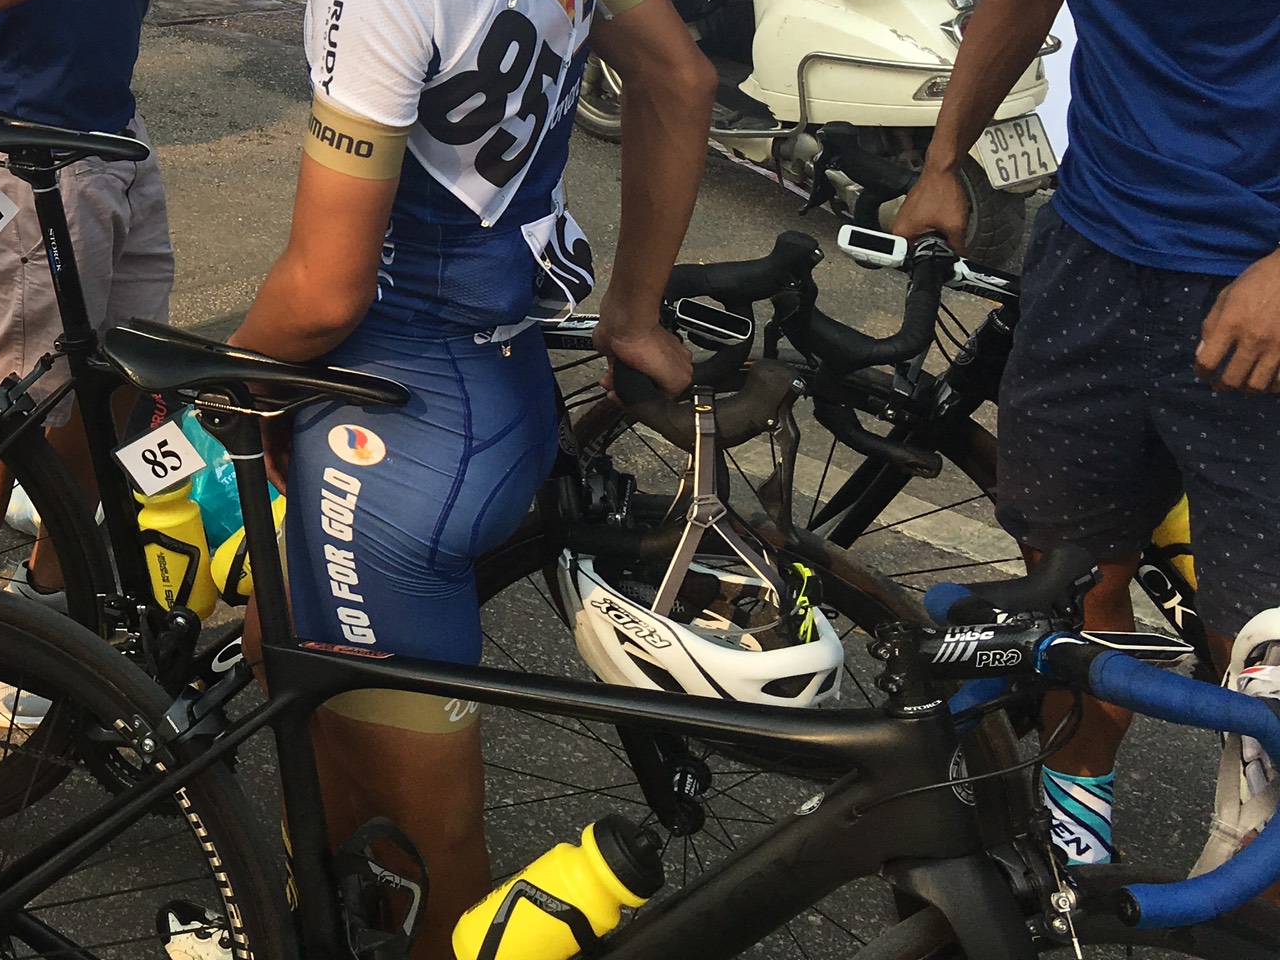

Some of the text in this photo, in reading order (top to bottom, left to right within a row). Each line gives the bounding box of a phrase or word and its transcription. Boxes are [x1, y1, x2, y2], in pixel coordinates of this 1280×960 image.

[321, 0, 344, 97] RUDY
[417, 9, 565, 189] 85
[995, 147, 1049, 183] 6724
[49, 228, 63, 272] STORCK
[141, 438, 185, 479] 85
[320, 467, 362, 542] GOLD
[323, 543, 364, 603] FOR
[336, 606, 377, 645] GO
[591, 600, 672, 649] RUDY
